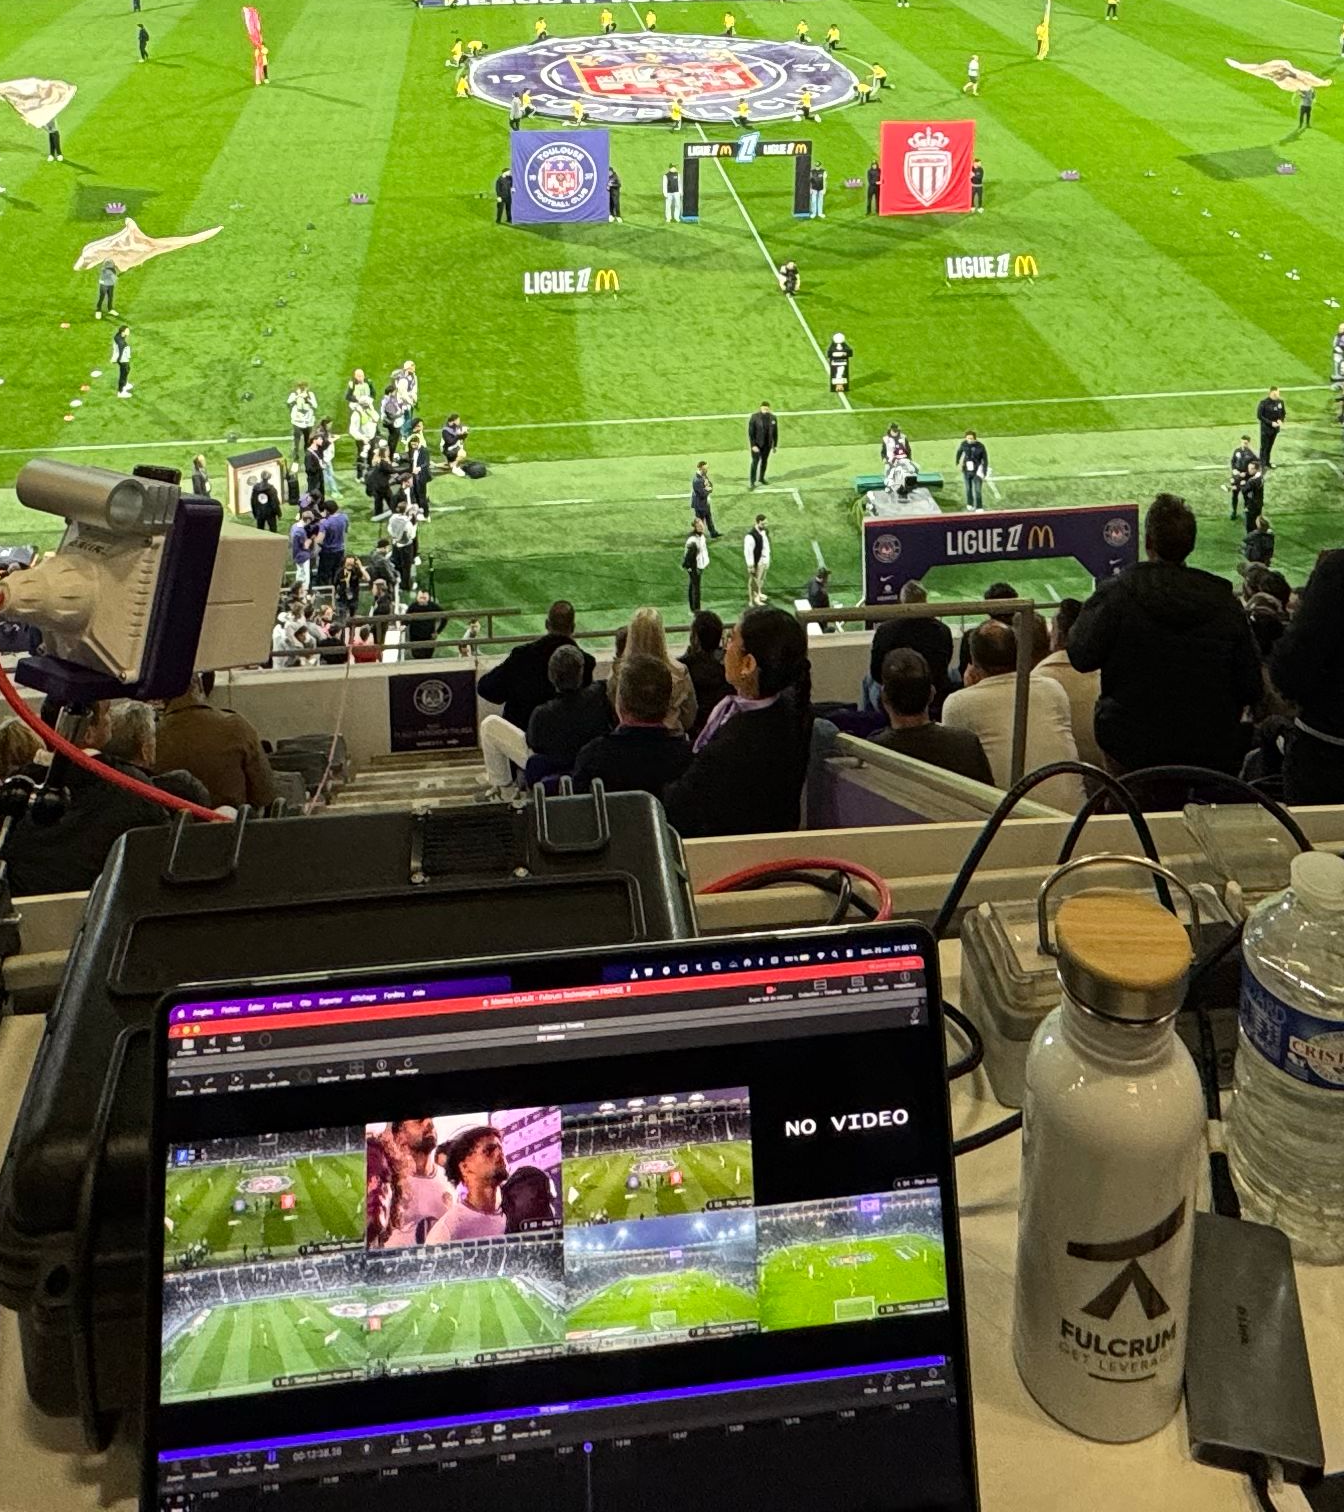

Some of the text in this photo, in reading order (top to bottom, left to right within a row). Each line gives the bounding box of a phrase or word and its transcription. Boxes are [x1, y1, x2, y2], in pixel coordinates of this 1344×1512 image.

[486, 73, 527, 84] 19
[536, 146, 585, 161] TOULOUSE
[688, 144, 711, 156] LIGUE
[763, 143, 787, 155] LIGUE
[946, 256, 997, 279] LIGUE
[524, 271, 575, 294] LIGUE
[946, 528, 1003, 556] LIGUE
[784, 1108, 910, 1138] NO VIDEO
[1061, 1317, 1177, 1358] FULCRUM
